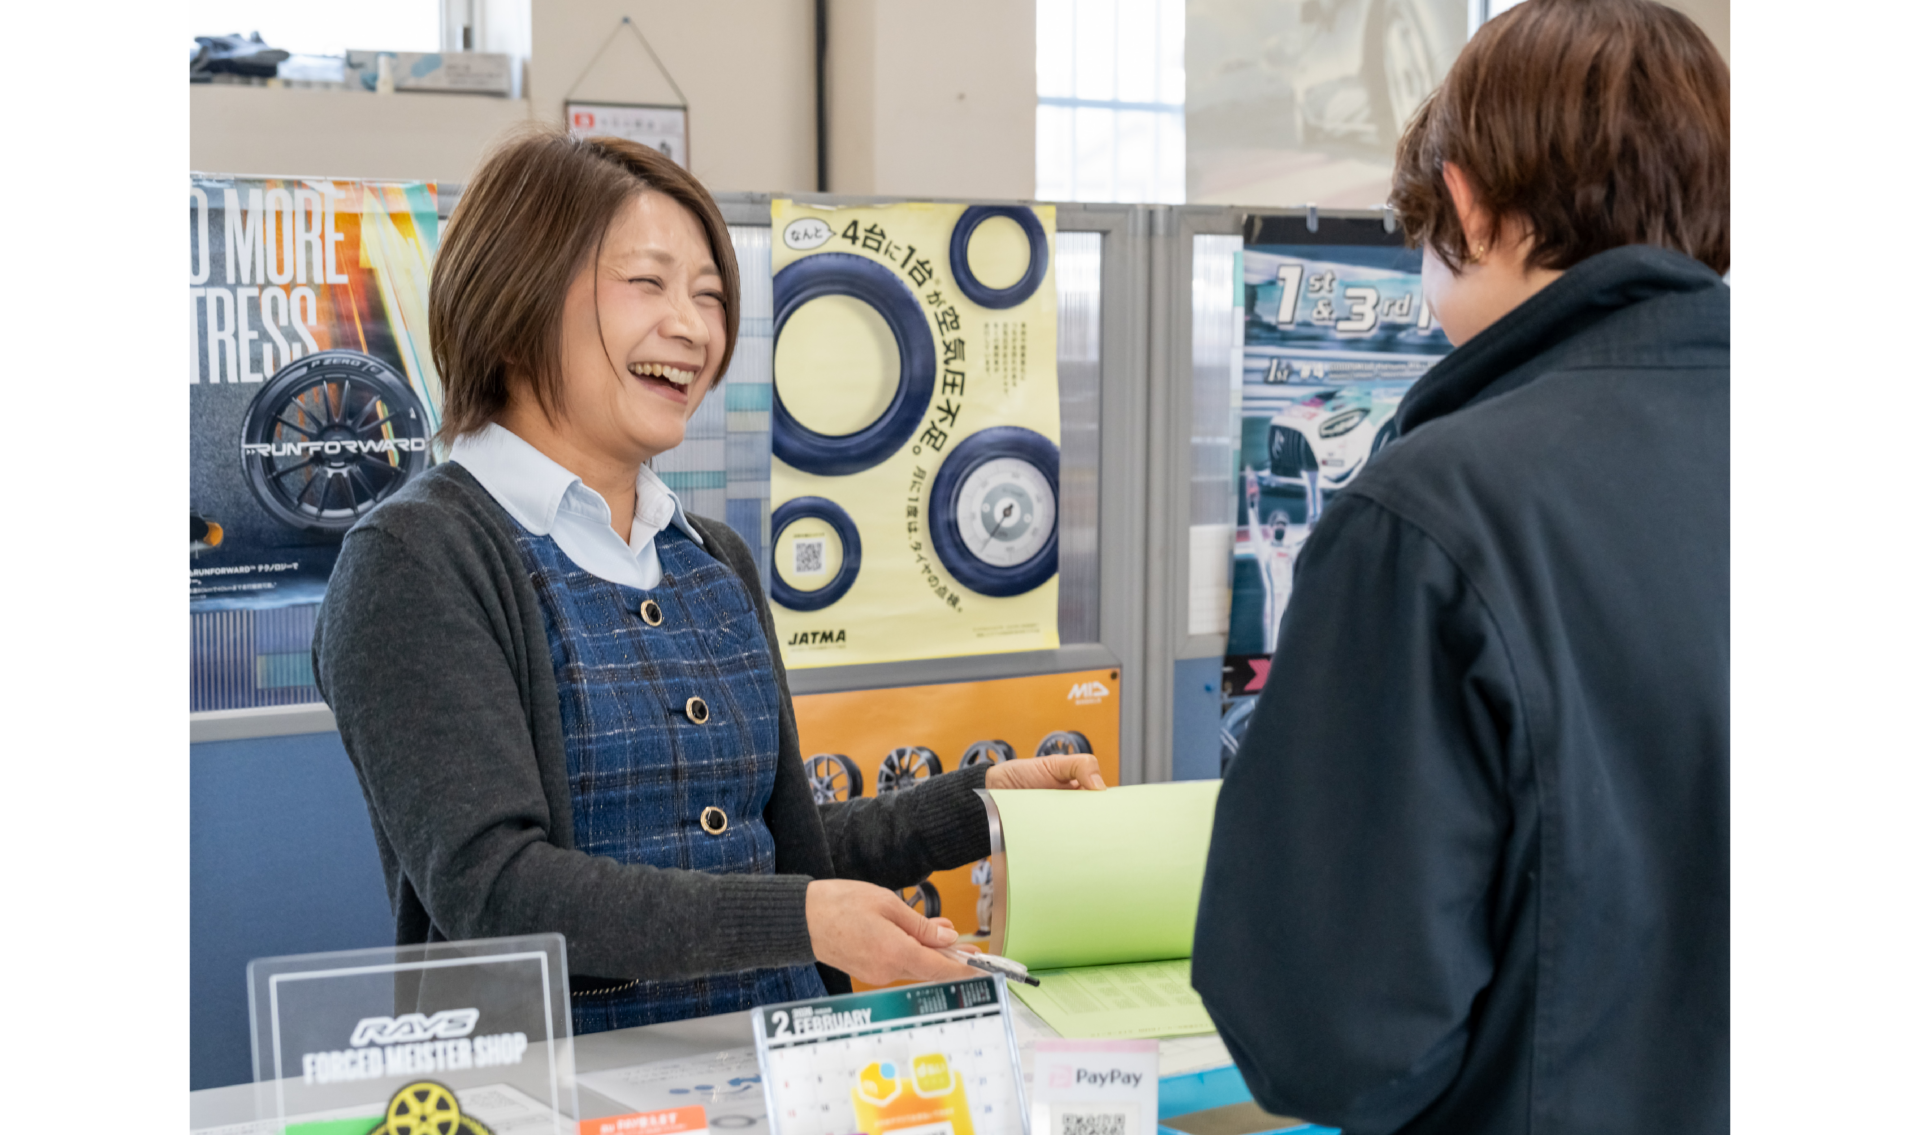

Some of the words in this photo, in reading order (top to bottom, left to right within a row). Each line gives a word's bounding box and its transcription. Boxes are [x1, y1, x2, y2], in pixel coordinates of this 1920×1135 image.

[224, 188, 349, 285] MORE
[791, 227, 823, 242] なんと
[1312, 299, 1334, 322] &
[323, 358, 362, 367] ZERO
[243, 437, 427, 457] RUNFORWARD
[788, 629, 847, 646] JATMA
[350, 1007, 480, 1047] RAYS
[771, 1010, 793, 1039] 2
[793, 1008, 872, 1036] FEBRUARY
[302, 1047, 384, 1085] FORGED
[385, 1038, 473, 1076] MEISTER
[473, 1032, 528, 1068] SHOP
[1076, 1067, 1143, 1088] PayPay
